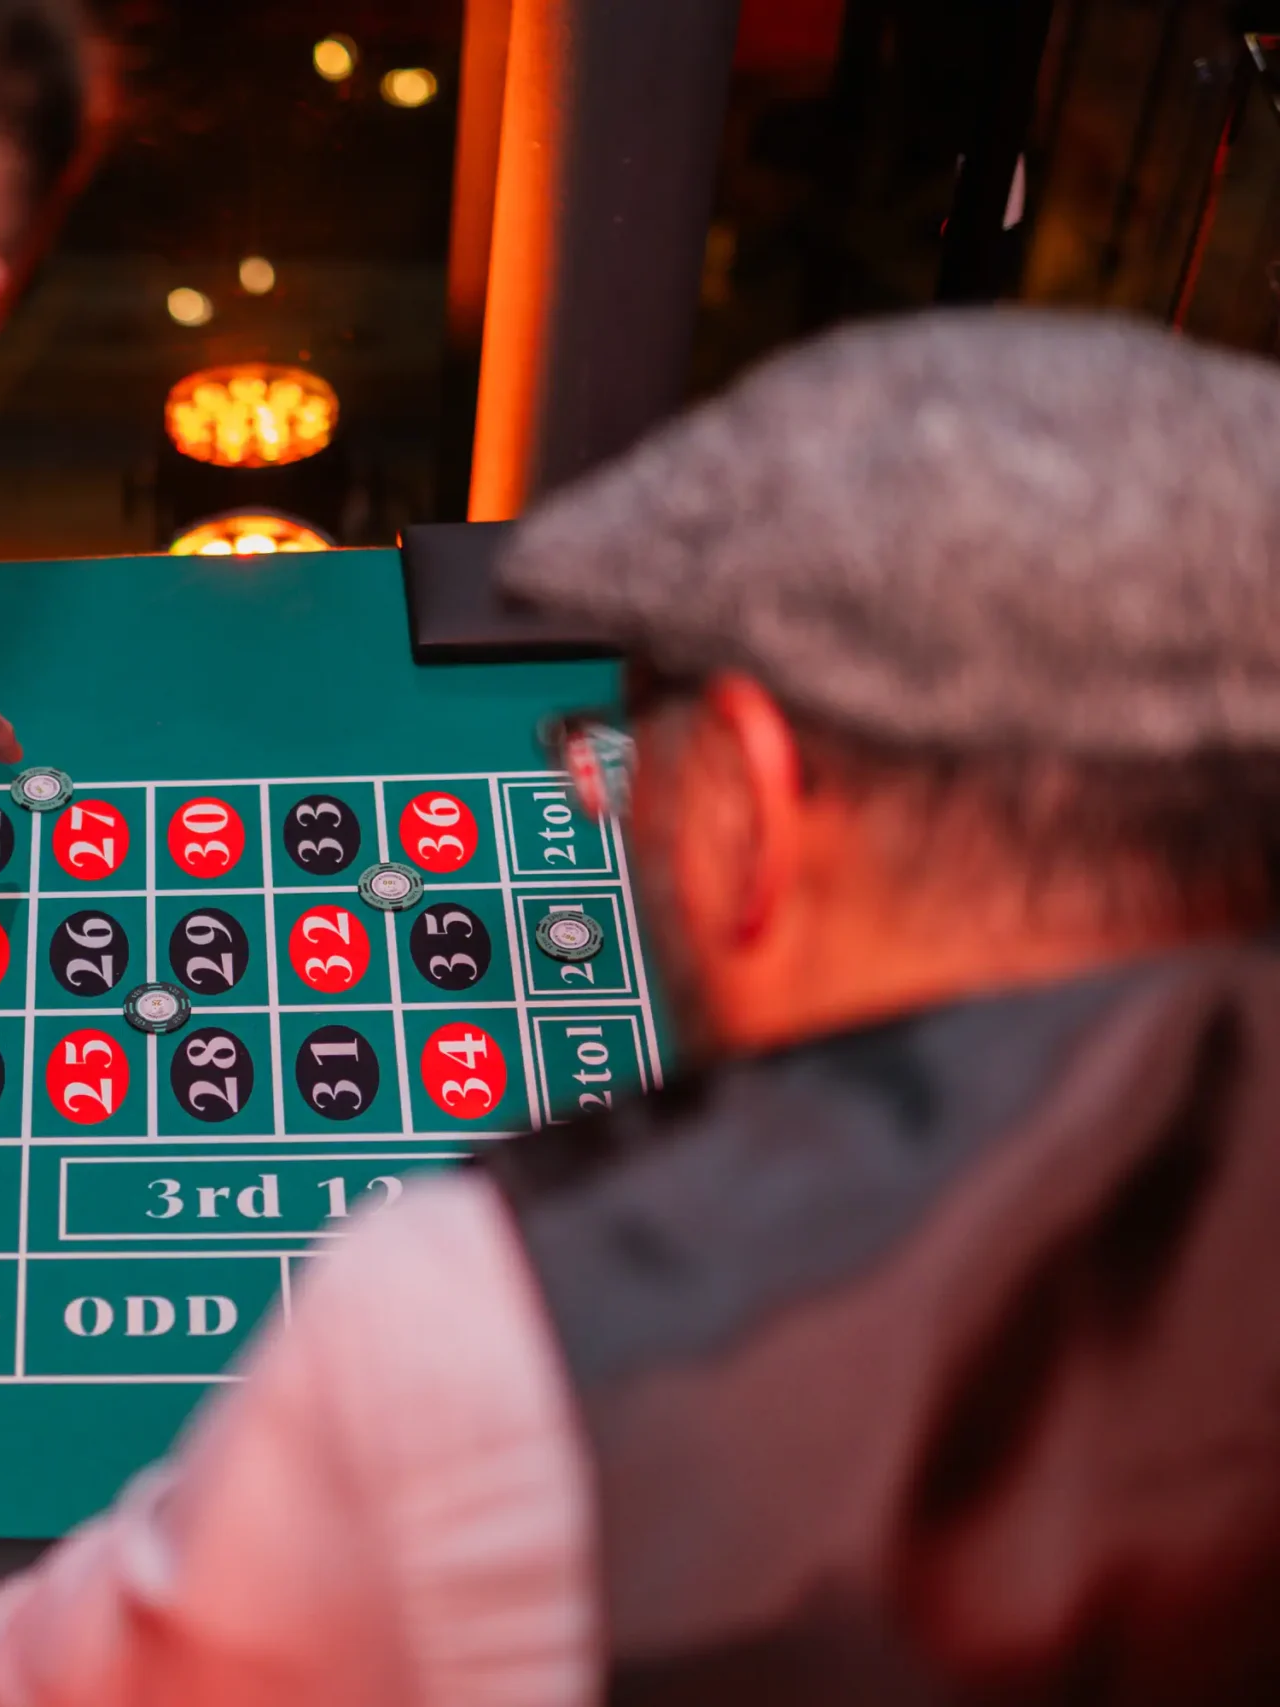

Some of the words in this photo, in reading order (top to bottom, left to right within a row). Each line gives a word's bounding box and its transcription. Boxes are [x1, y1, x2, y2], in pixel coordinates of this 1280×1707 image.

[69, 805, 115, 869] 27
[182, 803, 230, 866] 30
[296, 802, 344, 863] 33
[412, 797, 465, 861] 36
[65, 917, 114, 988] 26
[185, 914, 234, 986] 29
[302, 912, 353, 983] 32
[425, 910, 477, 981] 35
[63, 1038, 113, 1115] 25
[187, 1035, 238, 1112] 28
[311, 1037, 362, 1110] 31
[437, 1032, 493, 1107] 34
[145, 1174, 283, 1219] 3rd
[317, 1176, 404, 1218] 12
[64, 1295, 238, 1337] ODD
